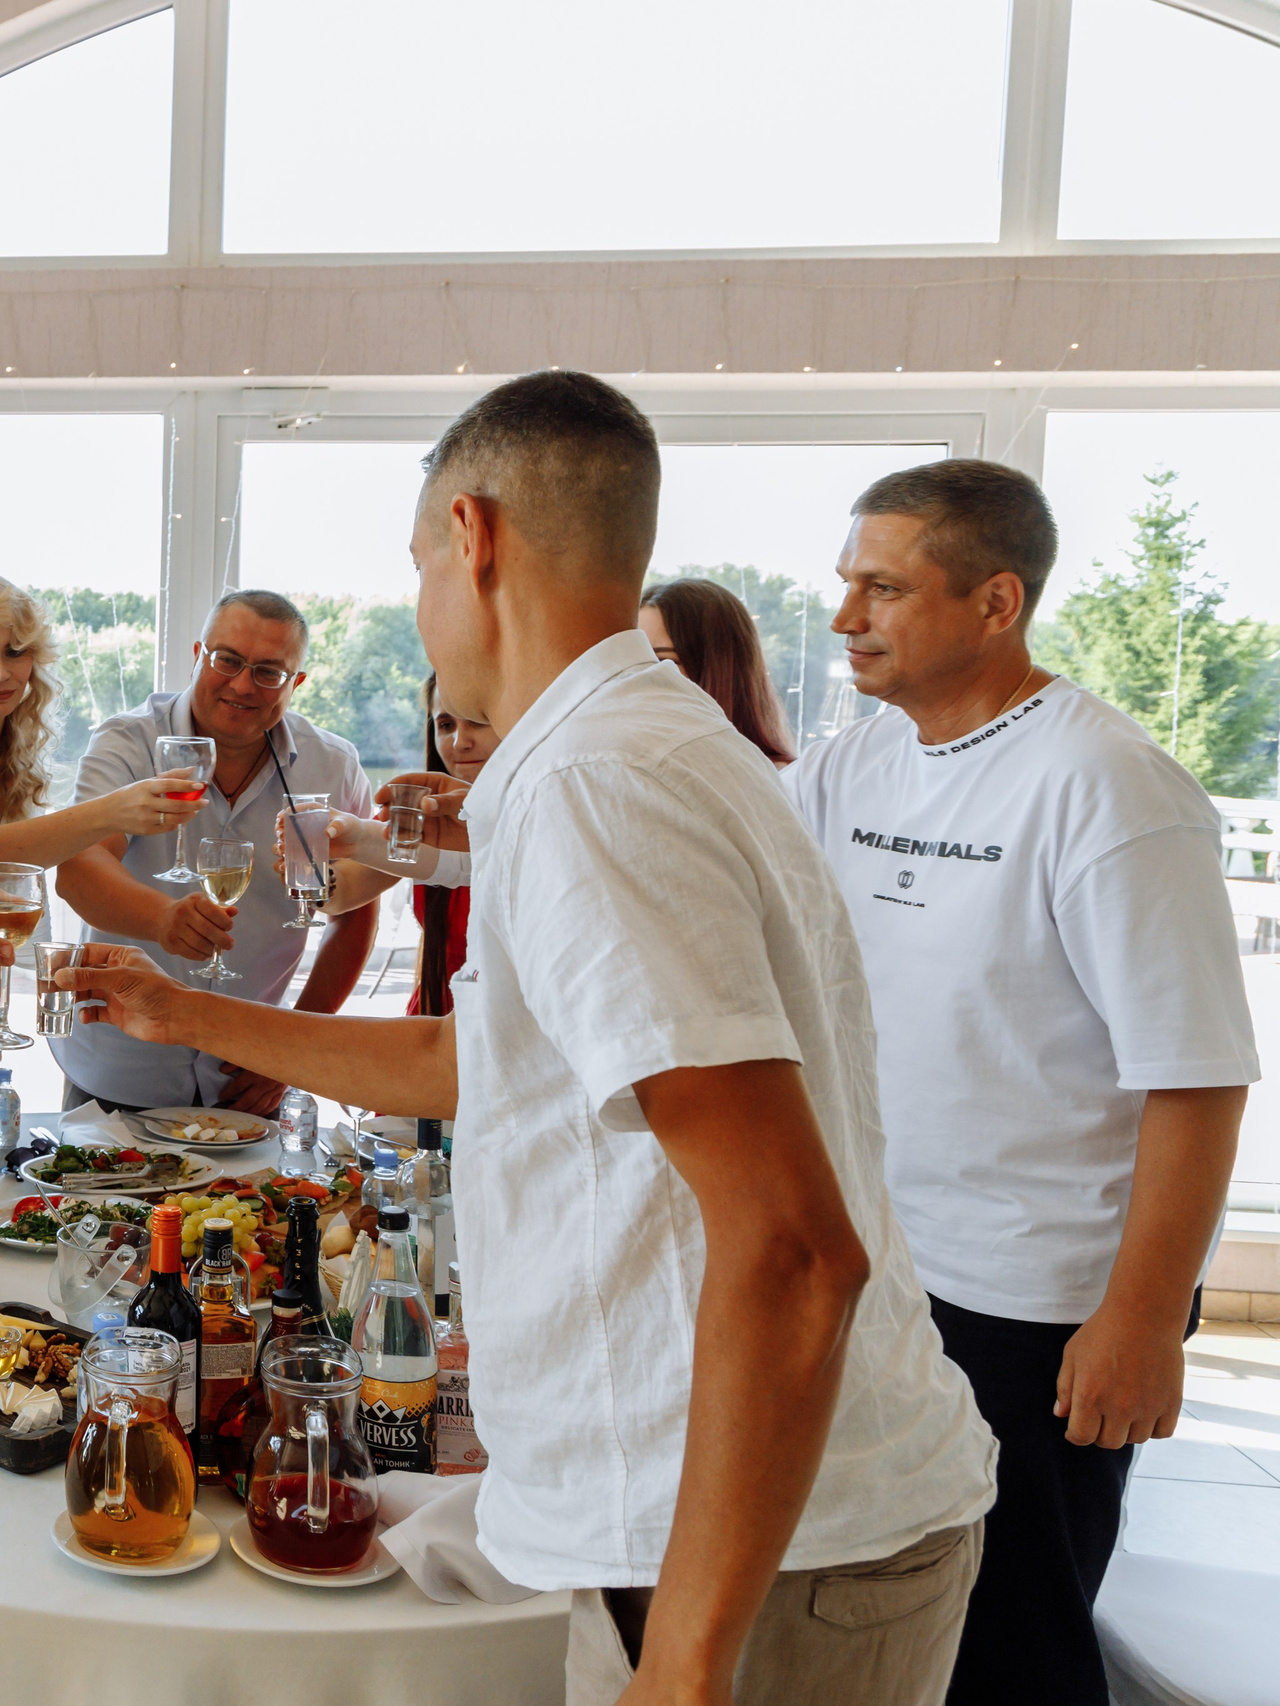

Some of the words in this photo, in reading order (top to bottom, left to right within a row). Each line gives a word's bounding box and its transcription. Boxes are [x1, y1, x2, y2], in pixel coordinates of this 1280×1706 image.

[950, 721, 1009, 754] DESIGN
[1011, 698, 1044, 720] LAB
[205, 1258, 220, 1268] BLACK
[437, 1396, 473, 1418] ARRI
[439, 1416, 467, 1427] PINK
[360, 1420, 417, 1447] VERVESS
[385, 1460, 410, 1468] ТОНИК
